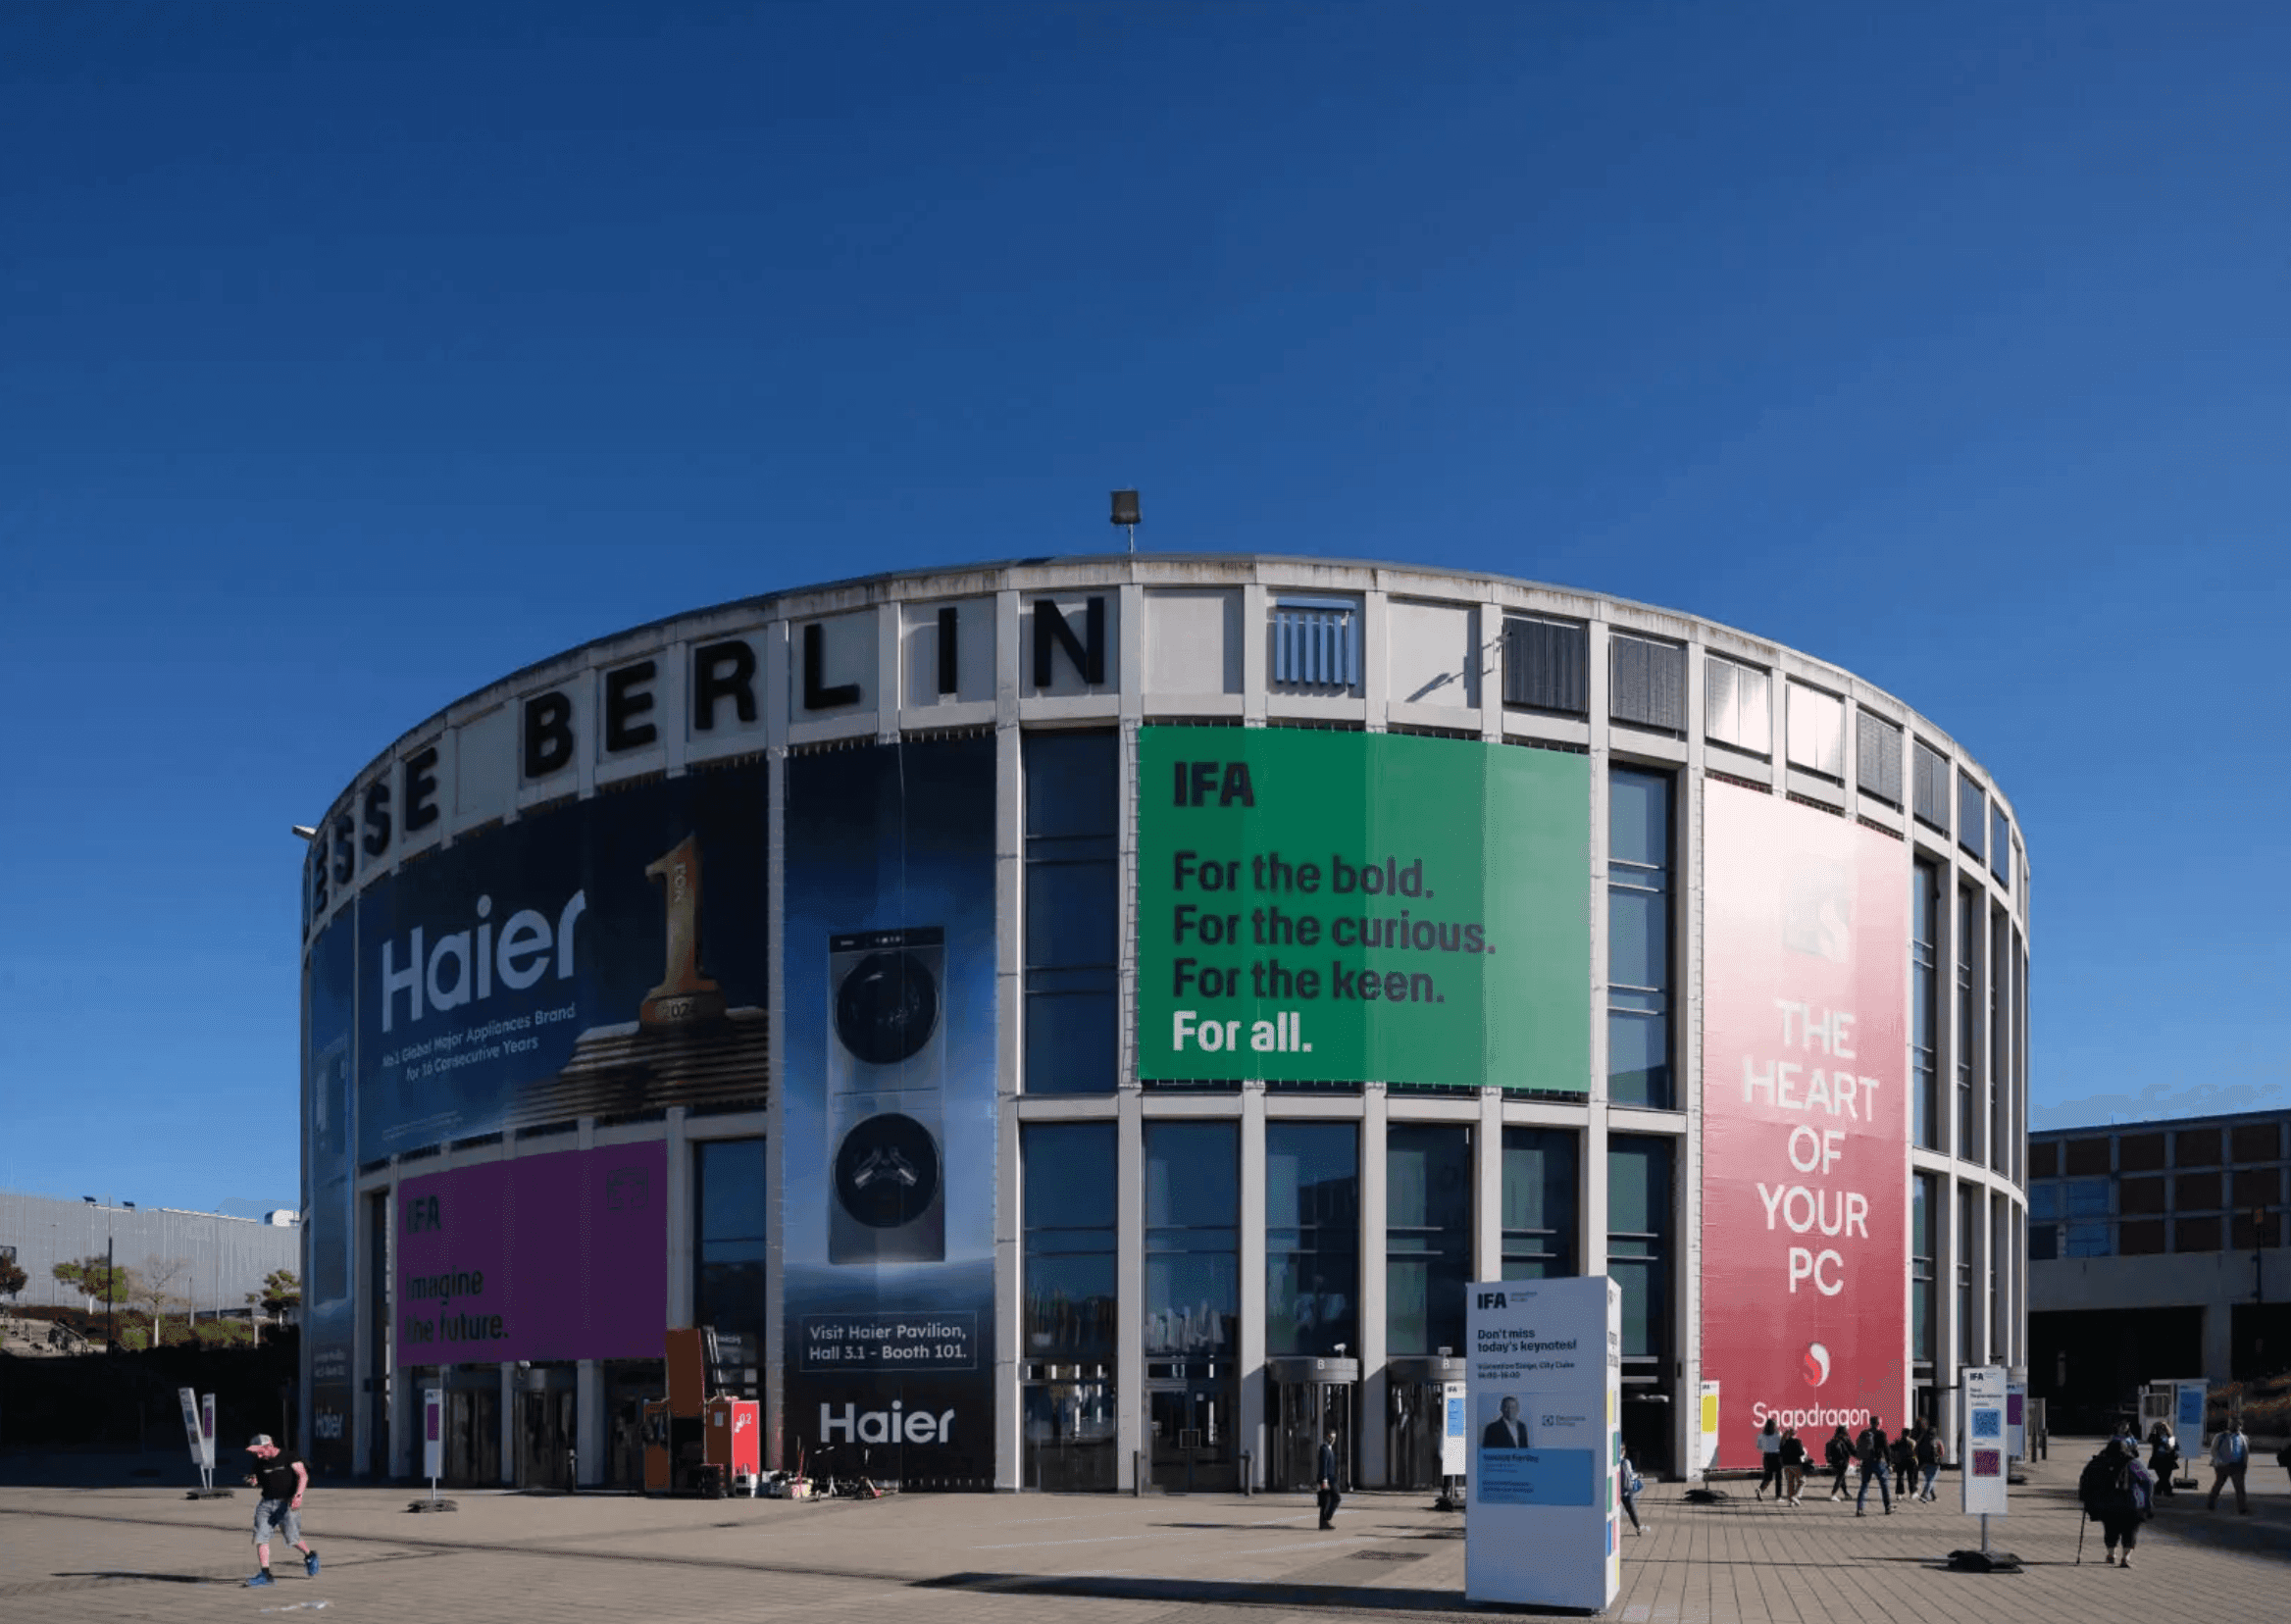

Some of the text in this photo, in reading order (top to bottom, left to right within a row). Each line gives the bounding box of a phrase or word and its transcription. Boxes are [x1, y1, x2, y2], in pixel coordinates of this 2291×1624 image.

[303, 596, 1105, 932] ESSE BERLIN
[1173, 761, 1255, 808] IFA
[1173, 850, 1435, 898] For the bold.
[1173, 904, 1497, 955] For the curious.
[382, 888, 586, 1033] Haier
[1173, 957, 1446, 1003] For the keen.
[402, 1038, 433, 1062] Global
[433, 1031, 465, 1052] Major
[466, 1014, 532, 1043] Appliances
[535, 1000, 577, 1026] Brand
[1173, 1011, 1313, 1052] For all.
[1774, 998, 1857, 1059] THE
[406, 1064, 420, 1082] for
[433, 1045, 500, 1074] Consecutive
[501, 1036, 539, 1056] Years
[1742, 1054, 1880, 1122] HEART
[1788, 1125, 1846, 1175] OF
[406, 1194, 441, 1235] IFA
[1756, 1183, 1869, 1239] YOUR
[1789, 1246, 1844, 1296] PC
[1477, 1292, 1507, 1309] IFA
[404, 1309, 509, 1344] the future.
[809, 1321, 967, 1341] Visit Haier Pavilion,
[1477, 1328, 1536, 1340] Don't miss
[1477, 1342, 1518, 1353] today's
[809, 1345, 840, 1361] Hall
[844, 1345, 865, 1360] 3.1
[882, 1345, 930, 1359] Booth
[935, 1344, 967, 1359] 101.
[820, 1399, 955, 1444] Haier
[1752, 1401, 1870, 1430] Snapdragon
